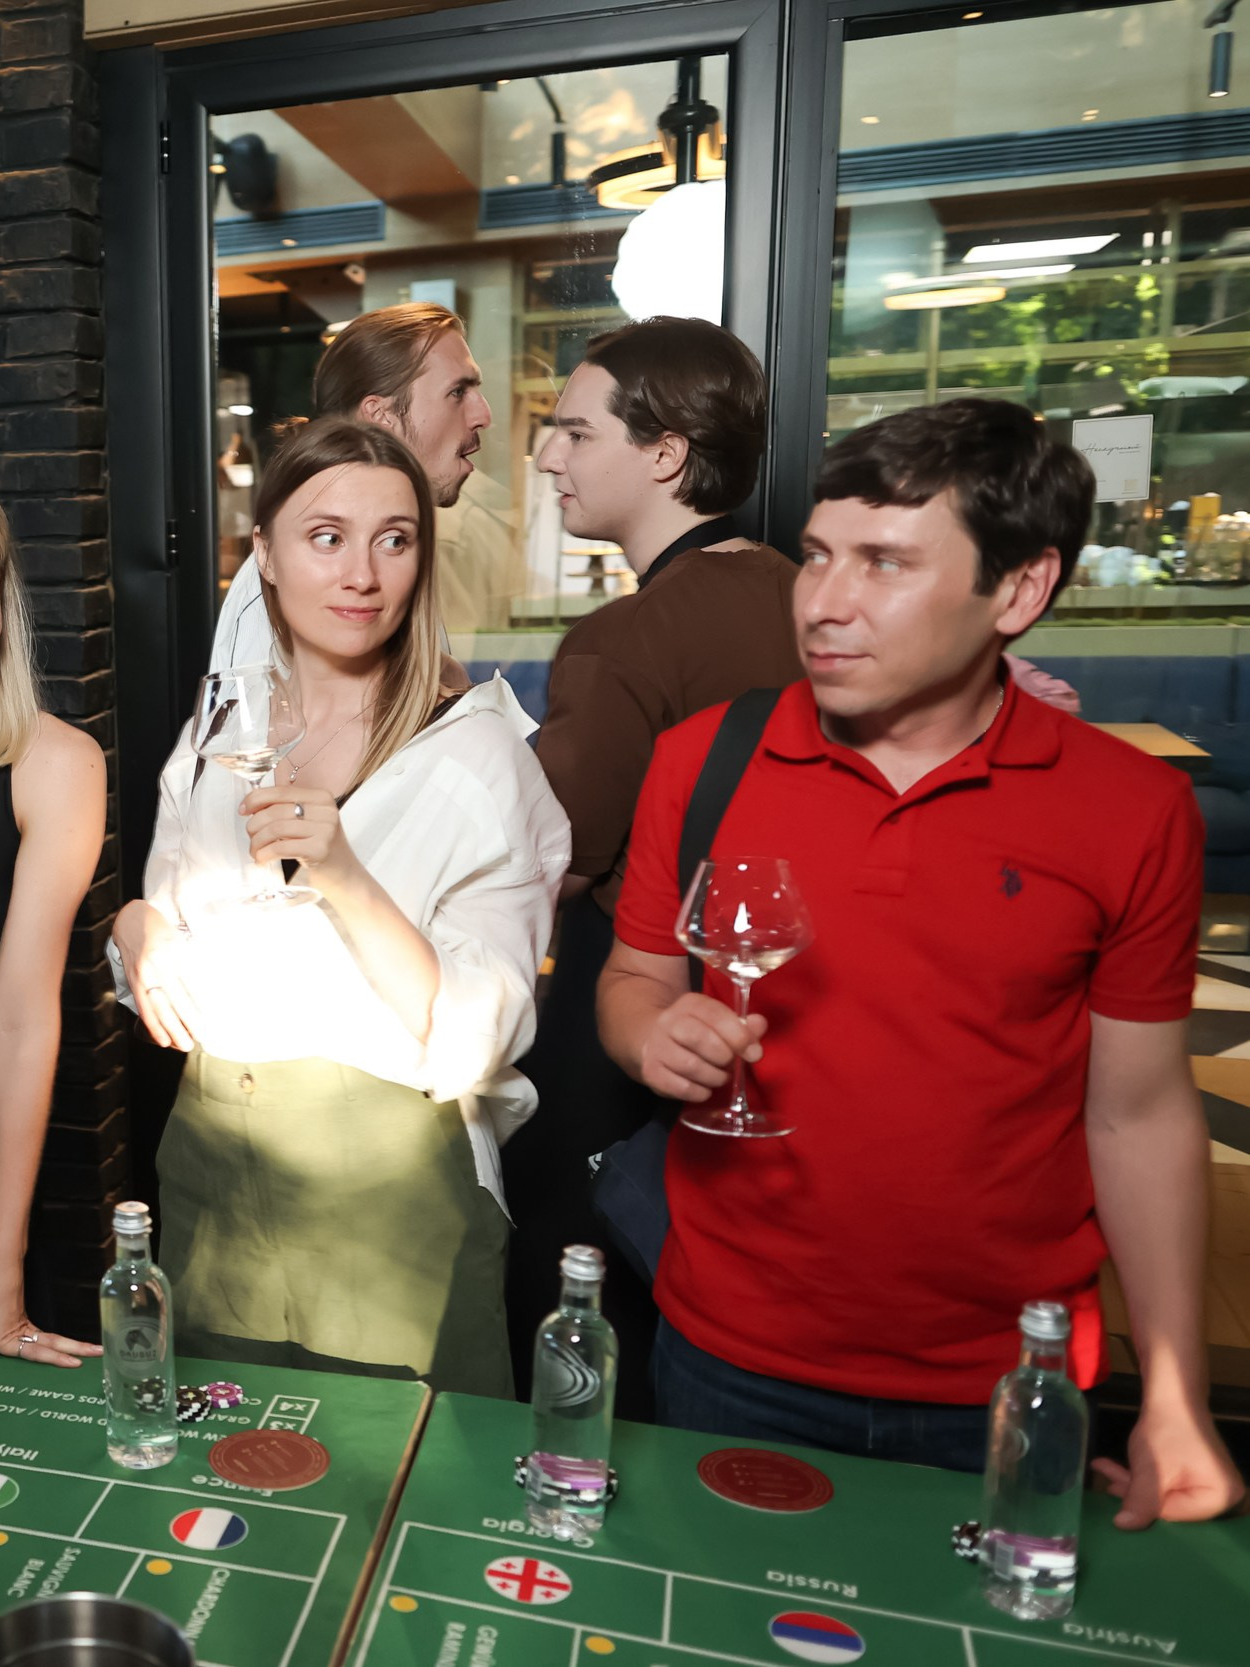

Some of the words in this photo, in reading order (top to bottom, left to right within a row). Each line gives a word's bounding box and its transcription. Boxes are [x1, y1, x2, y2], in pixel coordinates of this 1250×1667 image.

[29, 1388, 75, 1402] GAME
[40, 1409, 93, 1424] WORLD
[481, 1516, 594, 1549] Gorgia
[7, 1558, 46, 1599] BLANC
[766, 1568, 859, 1599] Russia
[1061, 1621, 1178, 1656] Austria
